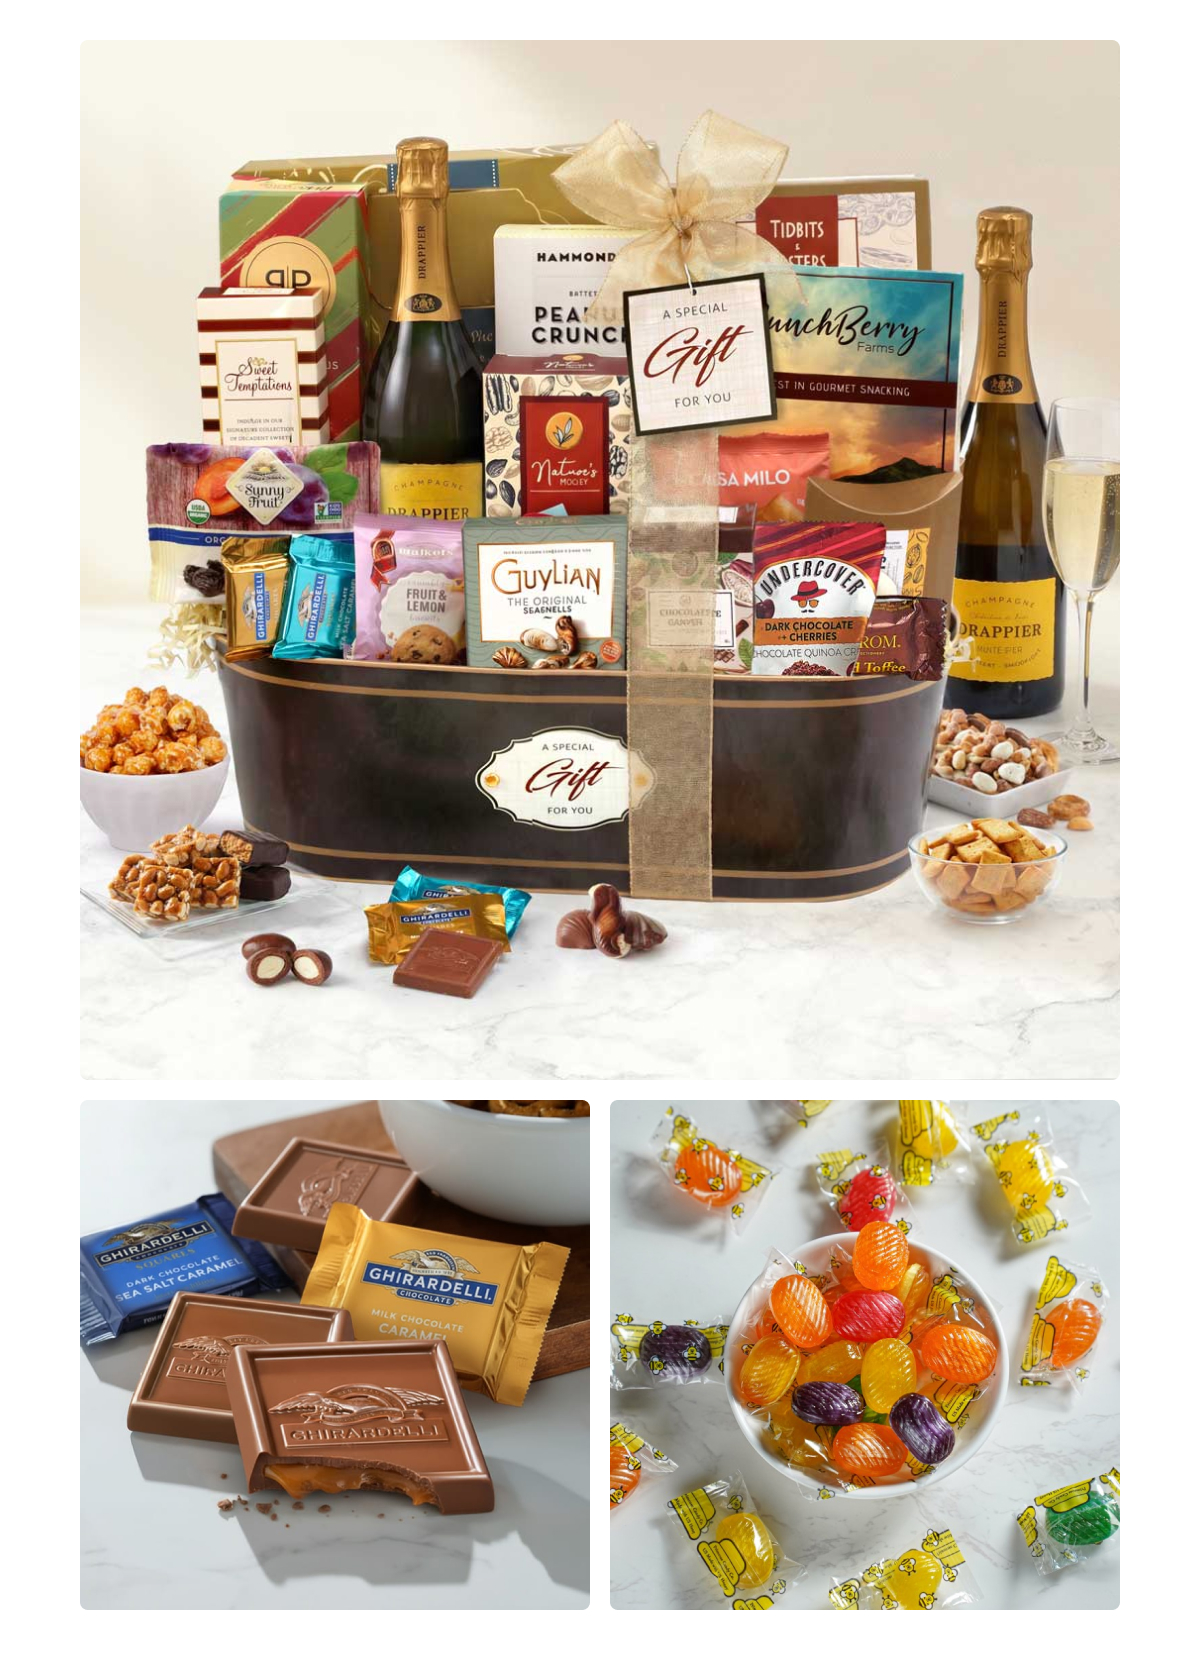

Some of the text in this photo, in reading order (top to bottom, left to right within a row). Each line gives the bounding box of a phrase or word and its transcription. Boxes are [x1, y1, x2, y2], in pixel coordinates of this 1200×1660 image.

[770, 220, 824, 238] TIDBITS
[417, 225, 427, 279] DRAPPIER
[662, 302, 728, 319] A SPECIAL
[997, 301, 1007, 358] DRAPPIER
[857, 342, 895, 354] Farms
[643, 325, 754, 388] Gift
[239, 357, 278, 376] Sweet
[224, 373, 293, 396] Temptations
[794, 381, 805, 391] IN
[809, 382, 856, 394] GOURMET
[860, 384, 910, 397] SNACKING
[675, 392, 731, 408] FOR YOU
[394, 479, 465, 492] CHAMPAGNE
[744, 469, 791, 487] MILO
[387, 507, 470, 520] DRAPPIER
[760, 560, 864, 597] UNDERCOVER
[406, 588, 448, 601] FRUIT &
[507, 595, 588, 607] THE ORIGINAL
[965, 596, 1036, 609] CHAMPAGNE
[407, 601, 446, 613] LEMON
[765, 620, 853, 632] DARK CHOCOLATE
[789, 632, 837, 642] CHERRIES
[804, 648, 842, 658] QUINOA
[864, 660, 906, 674] Toffee
[552, 743, 595, 751] SPECIAL
[525, 757, 625, 802] Gift
[547, 807, 593, 815] FOR YOU
[402, 910, 469, 923] GHIRARDELLI
[100, 1225, 209, 1264] GHIRARDELLI
[136, 1248, 196, 1271] SQUARES
[126, 1255, 221, 1288] DARK CHOCOLATE
[115, 1289, 142, 1302] SEA
[143, 1278, 175, 1294] SALT
[177, 1258, 243, 1282] CARAMEL
[400, 1290, 451, 1305] CHOCOLATE
[371, 1309, 464, 1333] MILK CHOCOLATE
[176, 1363, 226, 1378] GHIRA
[291, 1424, 440, 1441] GHIRARDELLI
